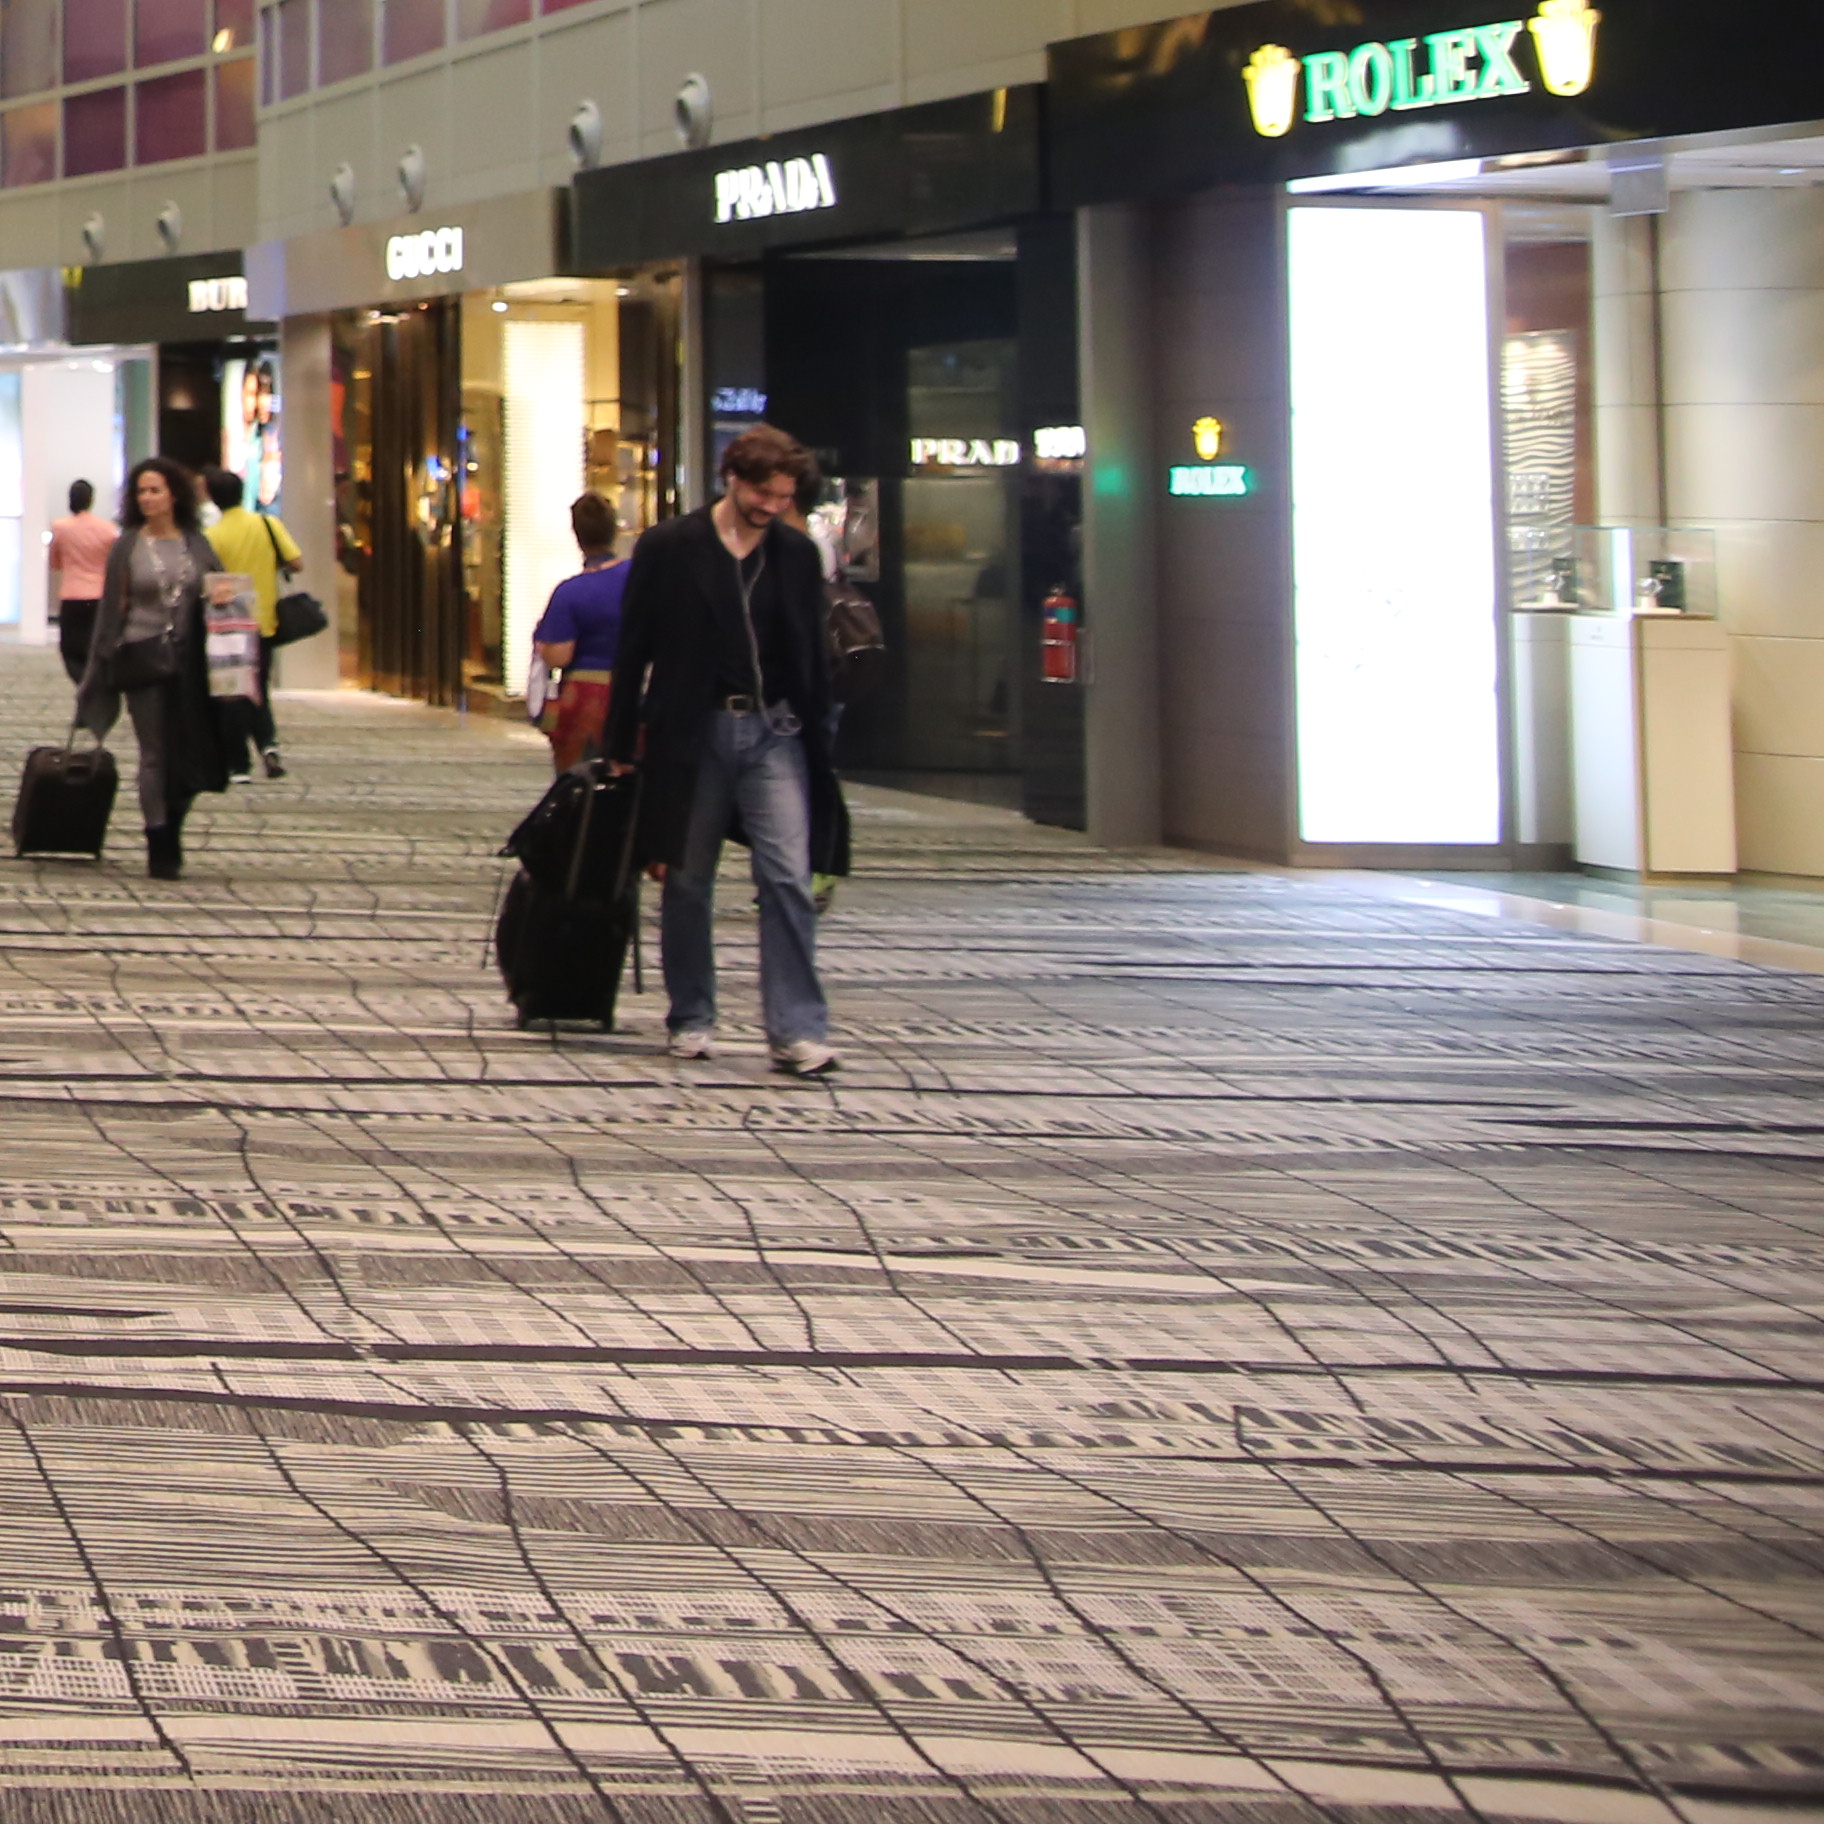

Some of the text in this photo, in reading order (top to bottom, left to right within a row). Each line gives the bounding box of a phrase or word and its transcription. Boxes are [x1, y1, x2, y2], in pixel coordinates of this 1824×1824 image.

[1302, 19, 1531, 124] ROLEX
[714, 152, 837, 224] PRADA
[386, 226, 463, 280] GUCCI
